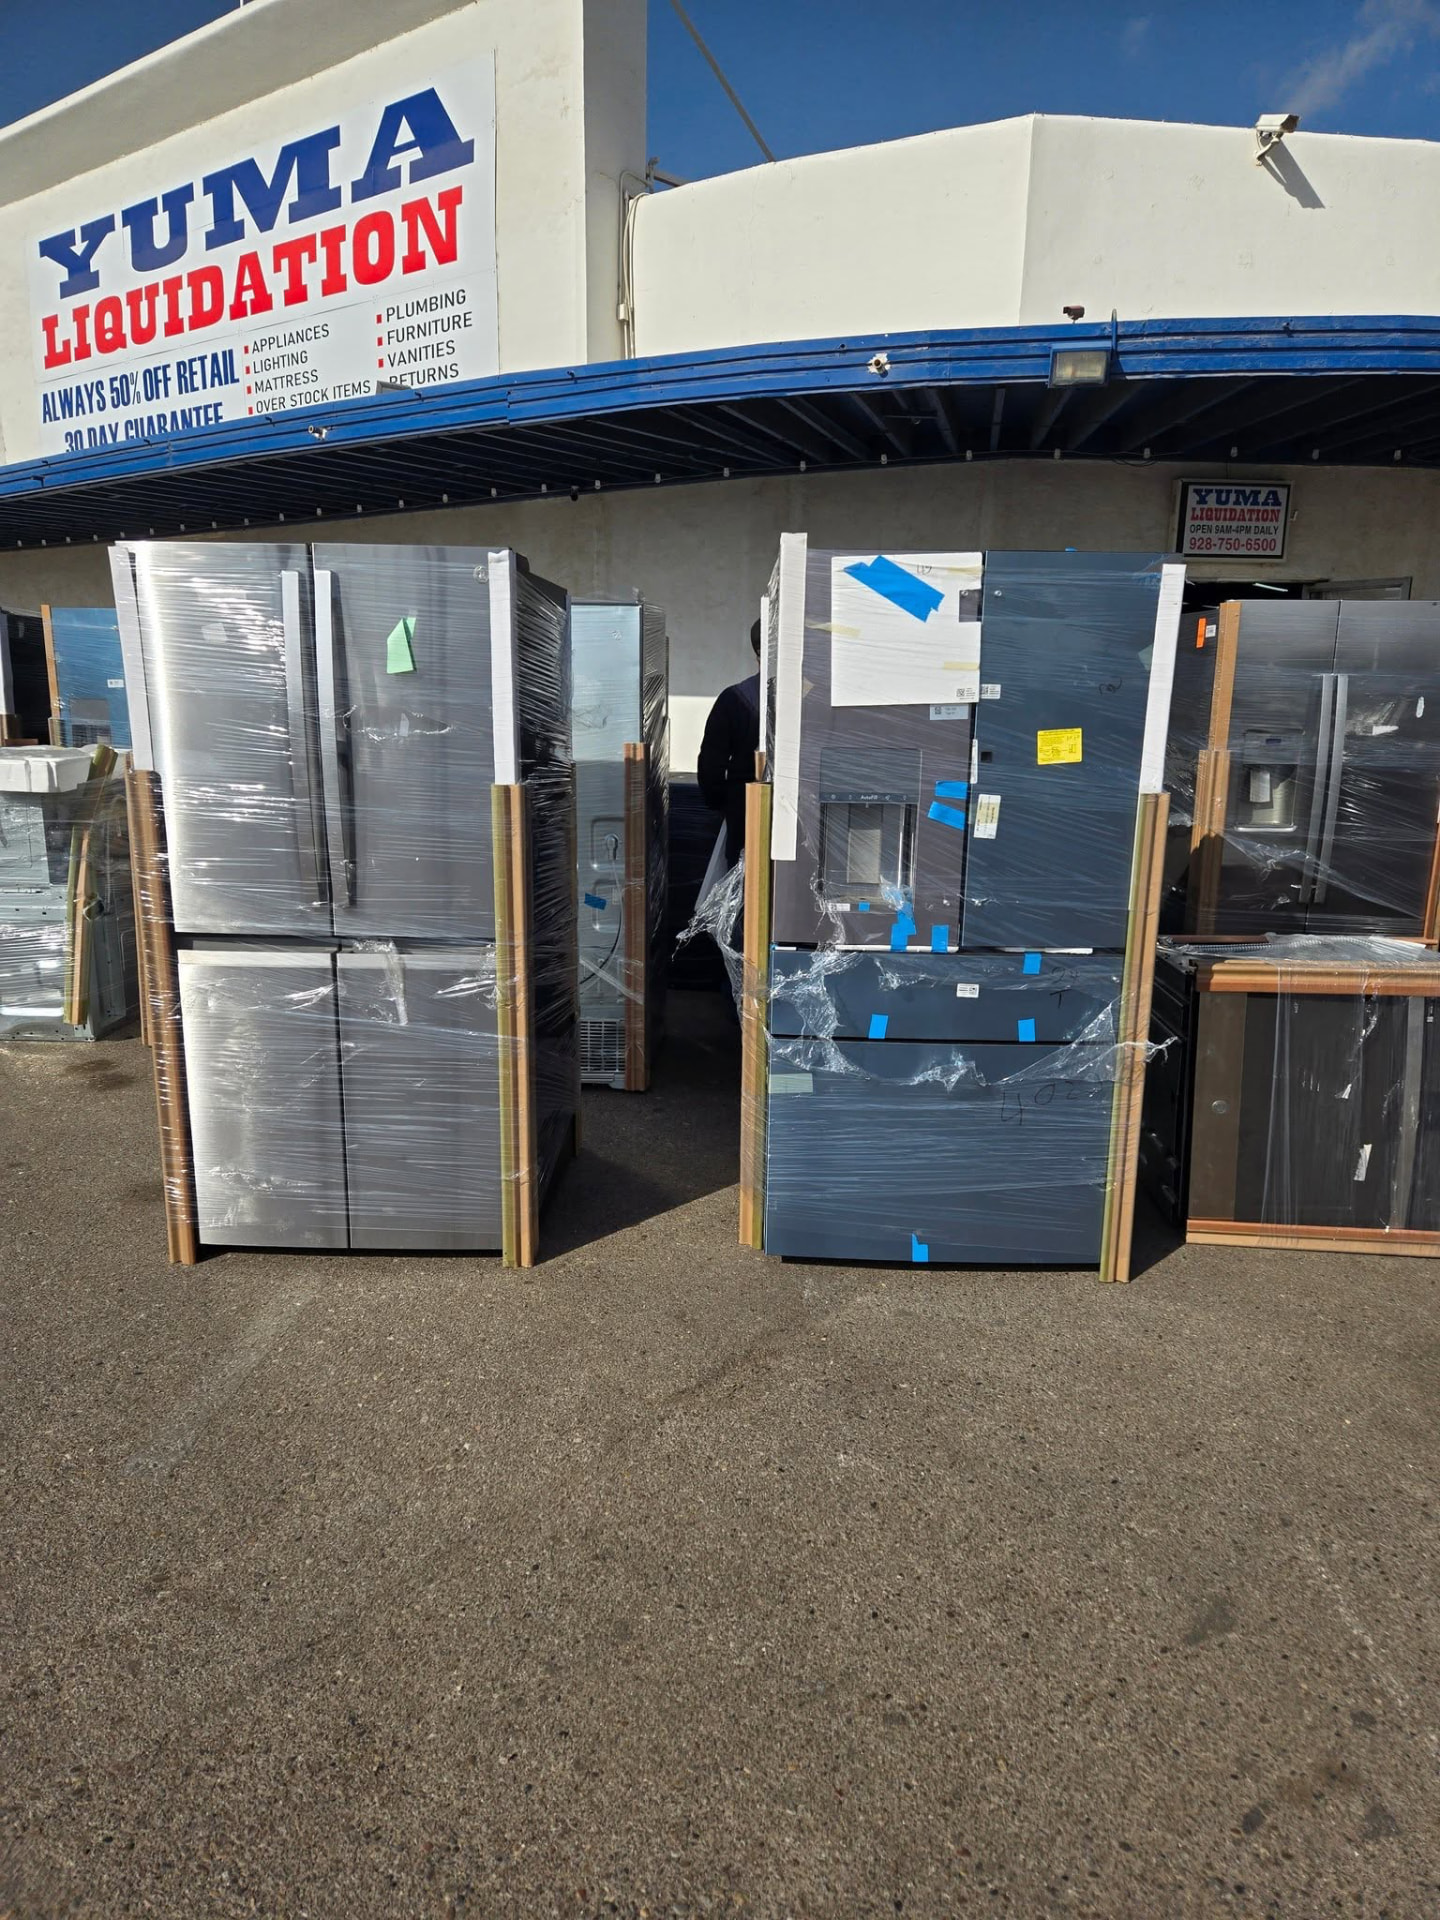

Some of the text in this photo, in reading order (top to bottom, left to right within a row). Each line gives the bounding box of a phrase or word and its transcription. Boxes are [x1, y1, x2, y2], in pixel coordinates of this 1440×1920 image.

[38, 86, 475, 299] YUMA
[41, 184, 463, 370] LIQUIDATION
[386, 288, 467, 323] PLUMBING
[252, 323, 330, 354] APPLIANCES
[387, 311, 473, 346] FURNITURE
[253, 350, 309, 375] LIGHTING
[387, 339, 456, 368] VANITIES
[42, 348, 240, 424] ALWAYS 50% OFF RETAIL
[254, 369, 319, 395] MATTRESS
[256, 380, 371, 414] OVER STOCK ITEMS
[65, 430, 80, 452] 30
[87, 421, 119, 450] DAY
[1193, 488, 1282, 507] YUMA
[1189, 524, 1279, 536] OPEN 9AM-4PM DAILY
[1190, 507, 1281, 522] LIQUIDATION
[1189, 537, 1277, 551] 928-750-6500
